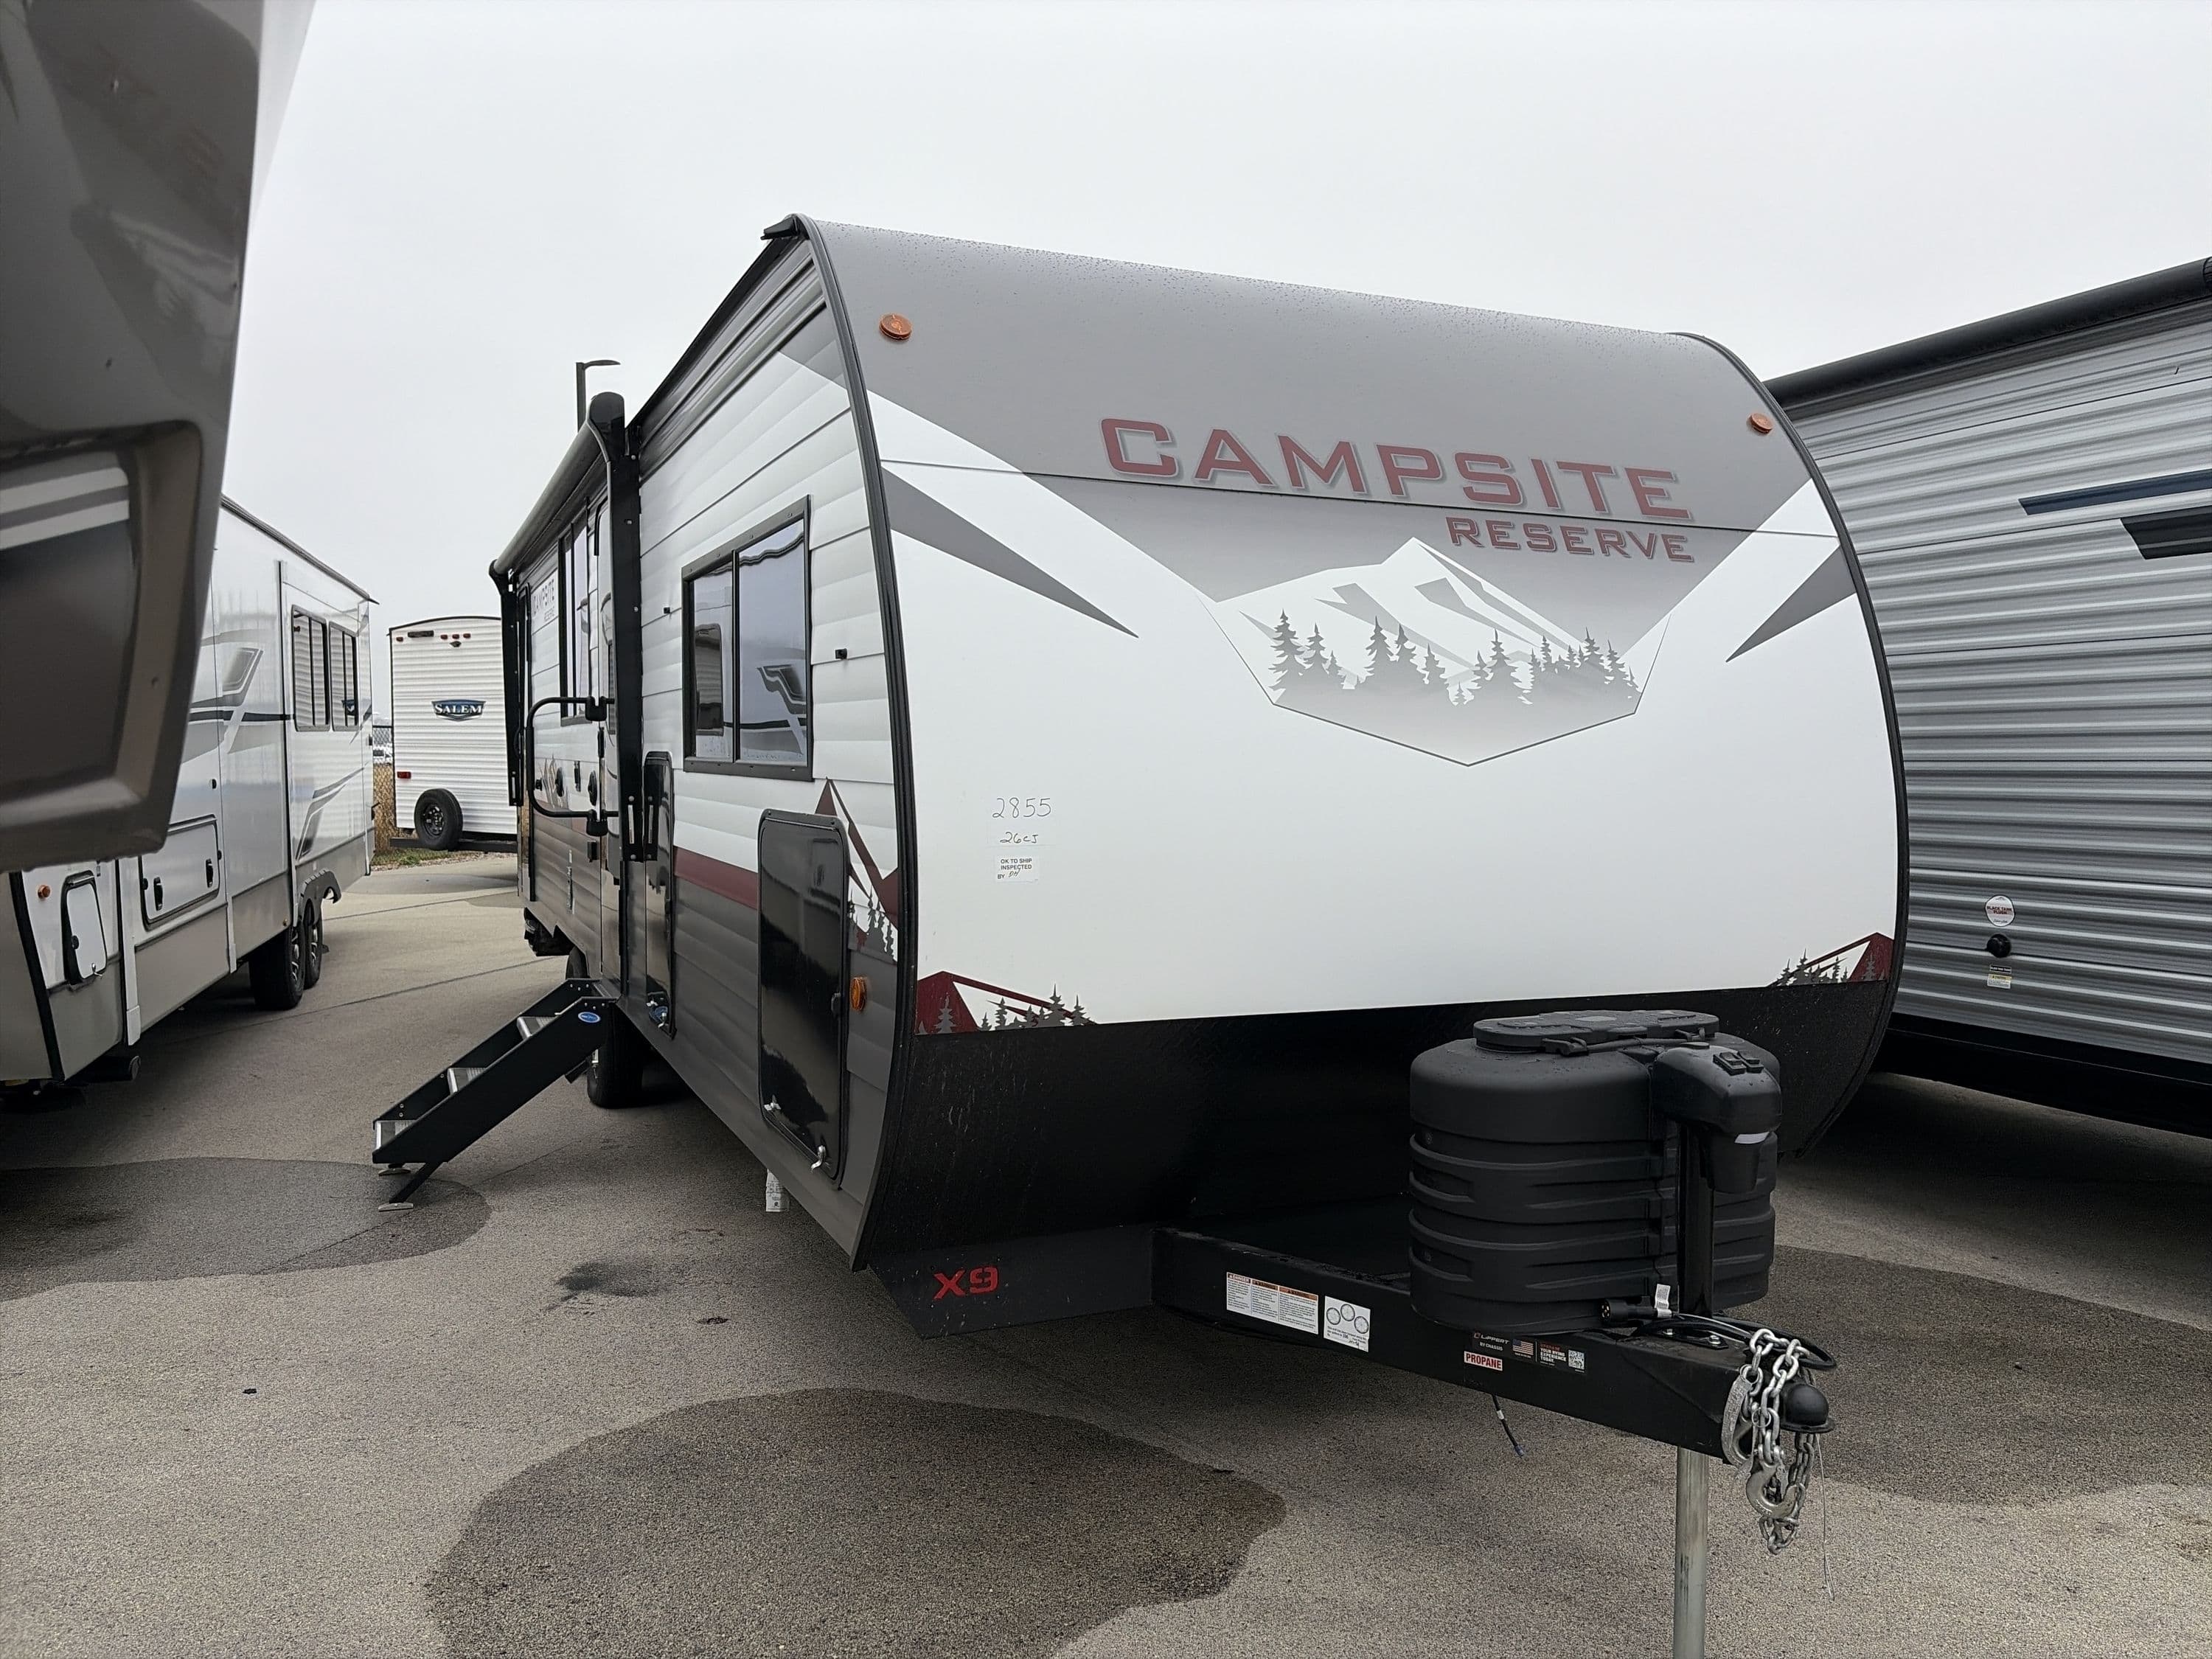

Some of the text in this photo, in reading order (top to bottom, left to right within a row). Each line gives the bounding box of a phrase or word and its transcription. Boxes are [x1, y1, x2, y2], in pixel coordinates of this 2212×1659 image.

[1100, 417, 1693, 519] CAMPSITE
[1445, 516, 1695, 563] RESERVE
[434, 703, 482, 714] SALEM
[992, 797, 1051, 818] 2855
[933, 1266, 999, 1301] X9
[1485, 1343, 1503, 1352] CHASSIS
[1466, 1353, 1502, 1369] PROPANE
[1540, 1352, 1567, 1362] EXPERIENCE
